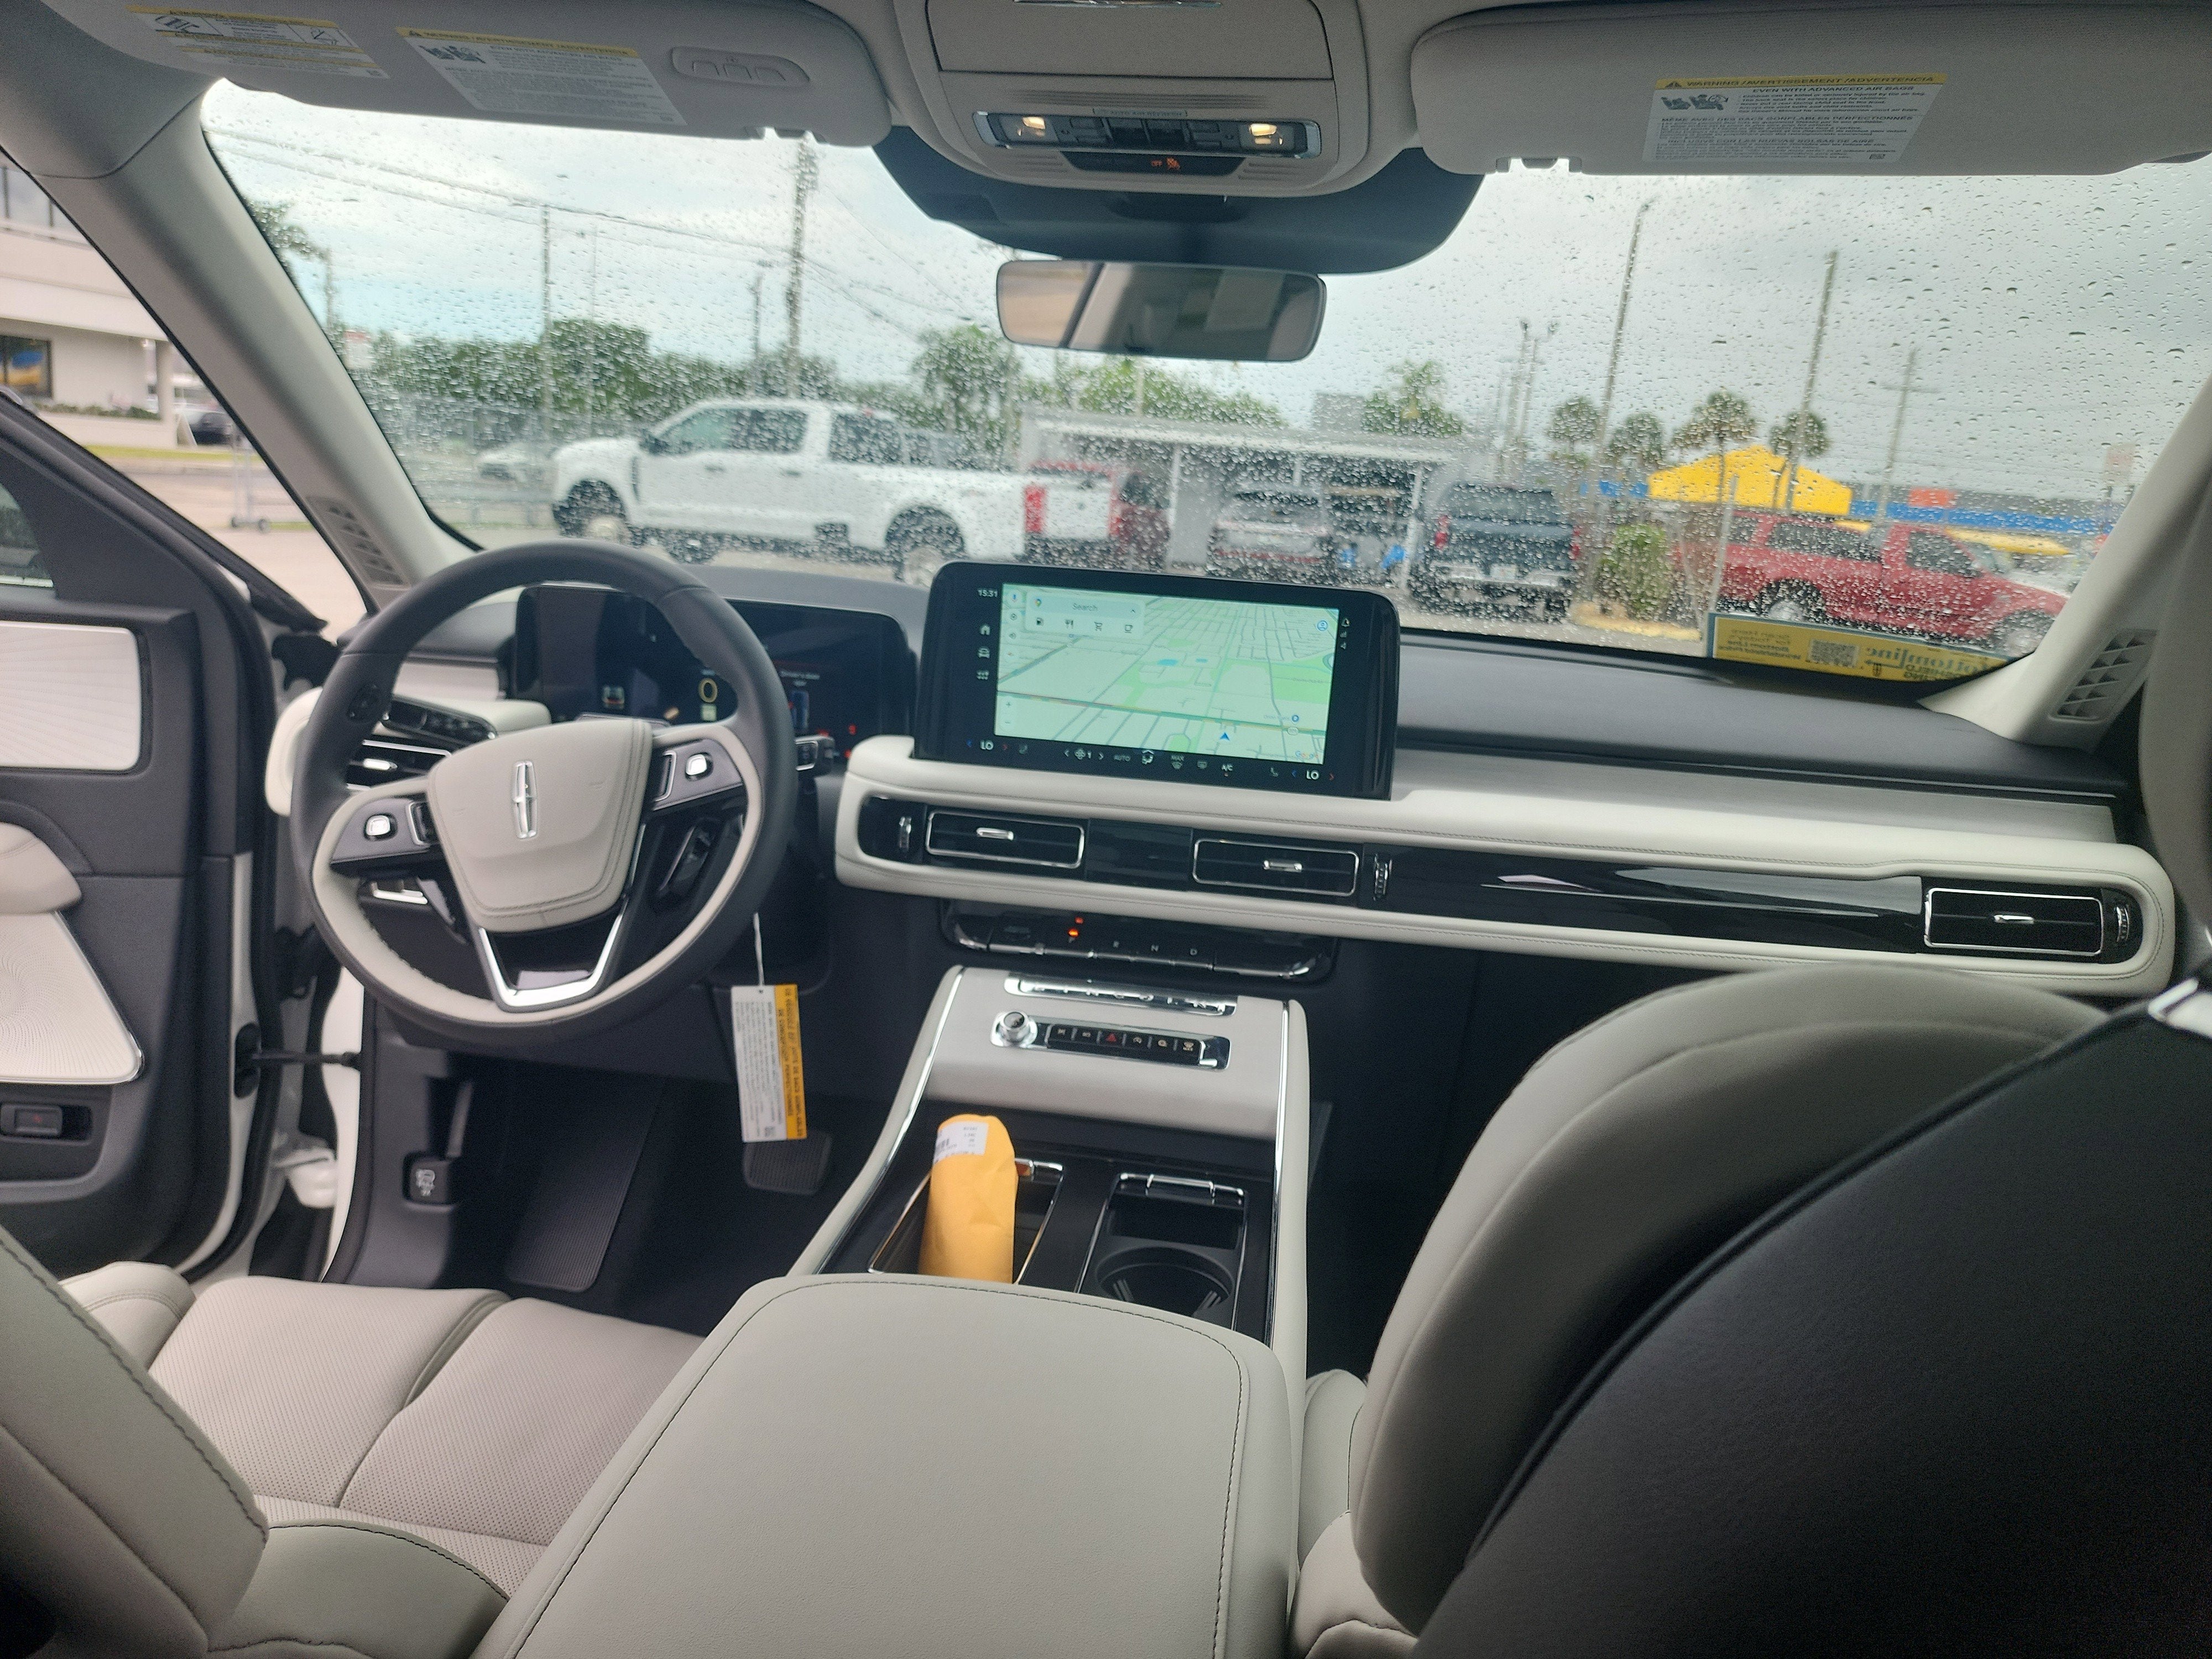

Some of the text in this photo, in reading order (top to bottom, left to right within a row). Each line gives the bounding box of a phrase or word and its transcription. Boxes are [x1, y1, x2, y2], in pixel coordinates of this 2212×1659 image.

[977, 588, 998, 598] 15:31
[1072, 602, 1098, 612] Search
[980, 739, 994, 750] LO
[1113, 754, 1131, 762] AUTO
[1221, 763, 1233, 772] A/C
[1306, 769, 1320, 780] LO
[1150, 943, 1159, 952] N
[1190, 948, 1198, 956] D
